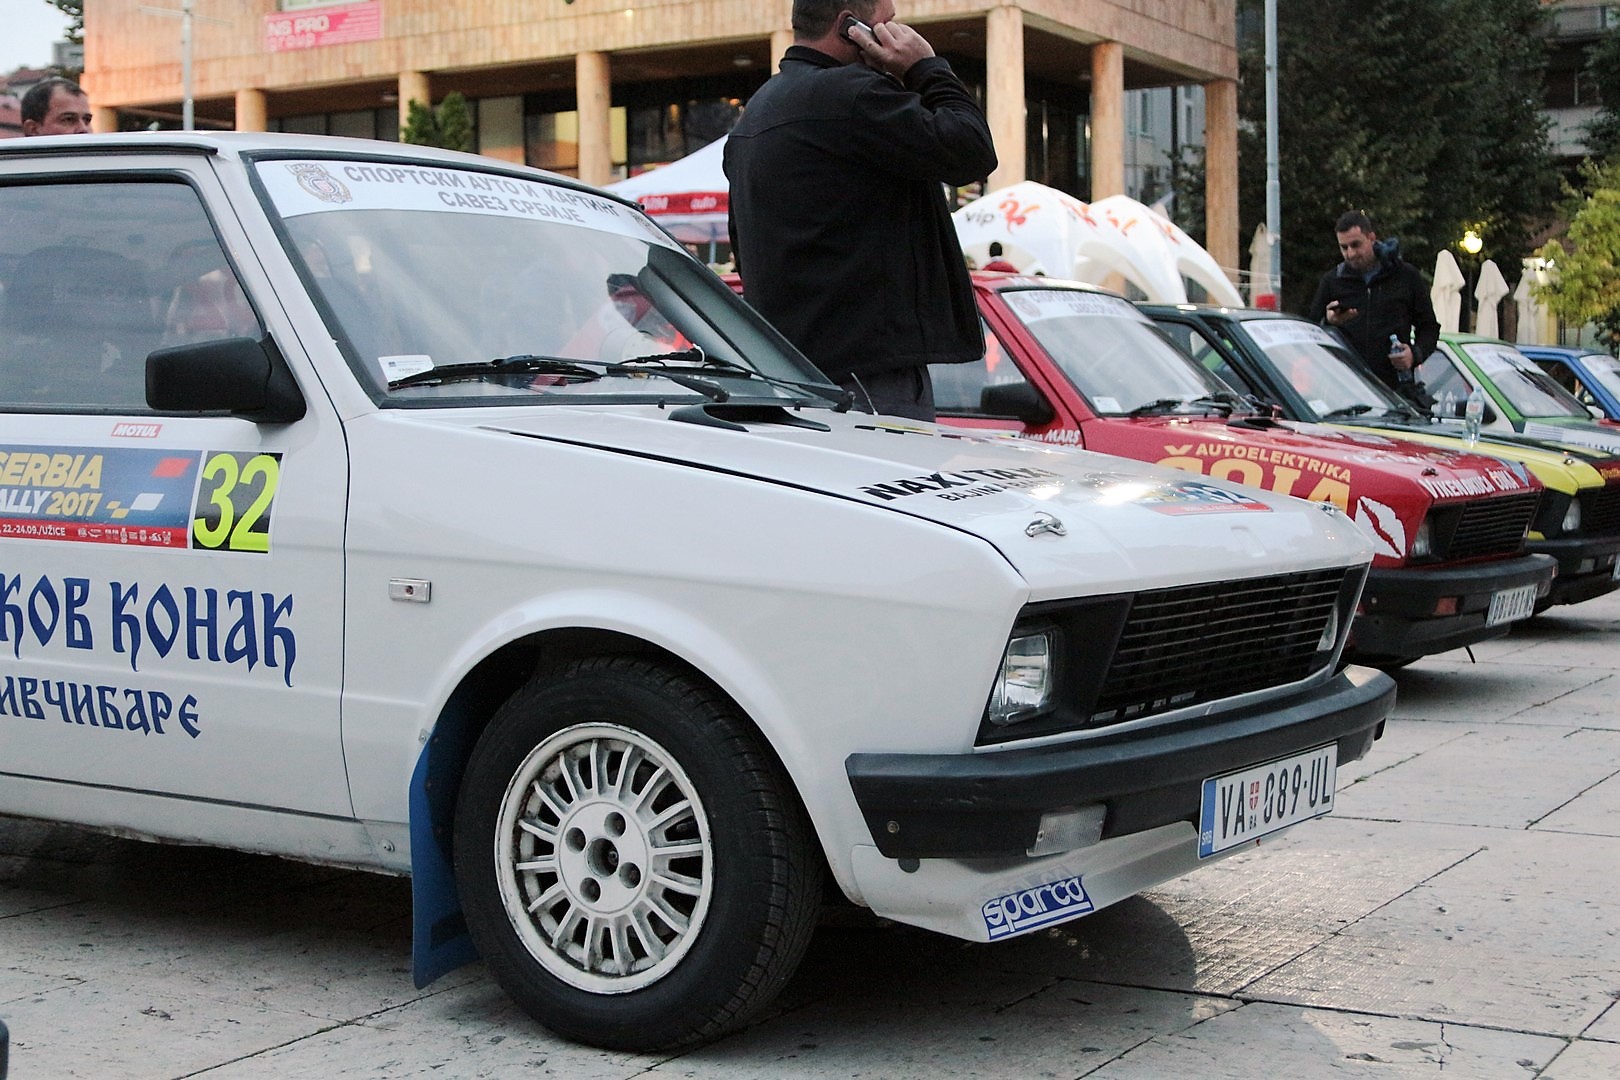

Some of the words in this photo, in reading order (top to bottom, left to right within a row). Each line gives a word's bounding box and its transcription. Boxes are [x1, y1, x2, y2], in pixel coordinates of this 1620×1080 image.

[343, 165, 466, 188] СПОРТСКИ
[467, 175, 520, 196] АУТО
[519, 184, 541, 200] И
[543, 188, 620, 217] КАРТИНГ
[438, 191, 506, 212] САВЕЗ
[510, 199, 586, 224] СРБИЈЕ
[965, 208, 995, 227] vip
[113, 424, 159, 438] MOTUL
[1044, 428, 1080, 444] MARS
[1195, 443, 1351, 482] AUTOELEKTRIKA
[45, 491, 103, 517] 2017
[193, 453, 280, 551] 32
[1221, 781, 1245, 840] VA
